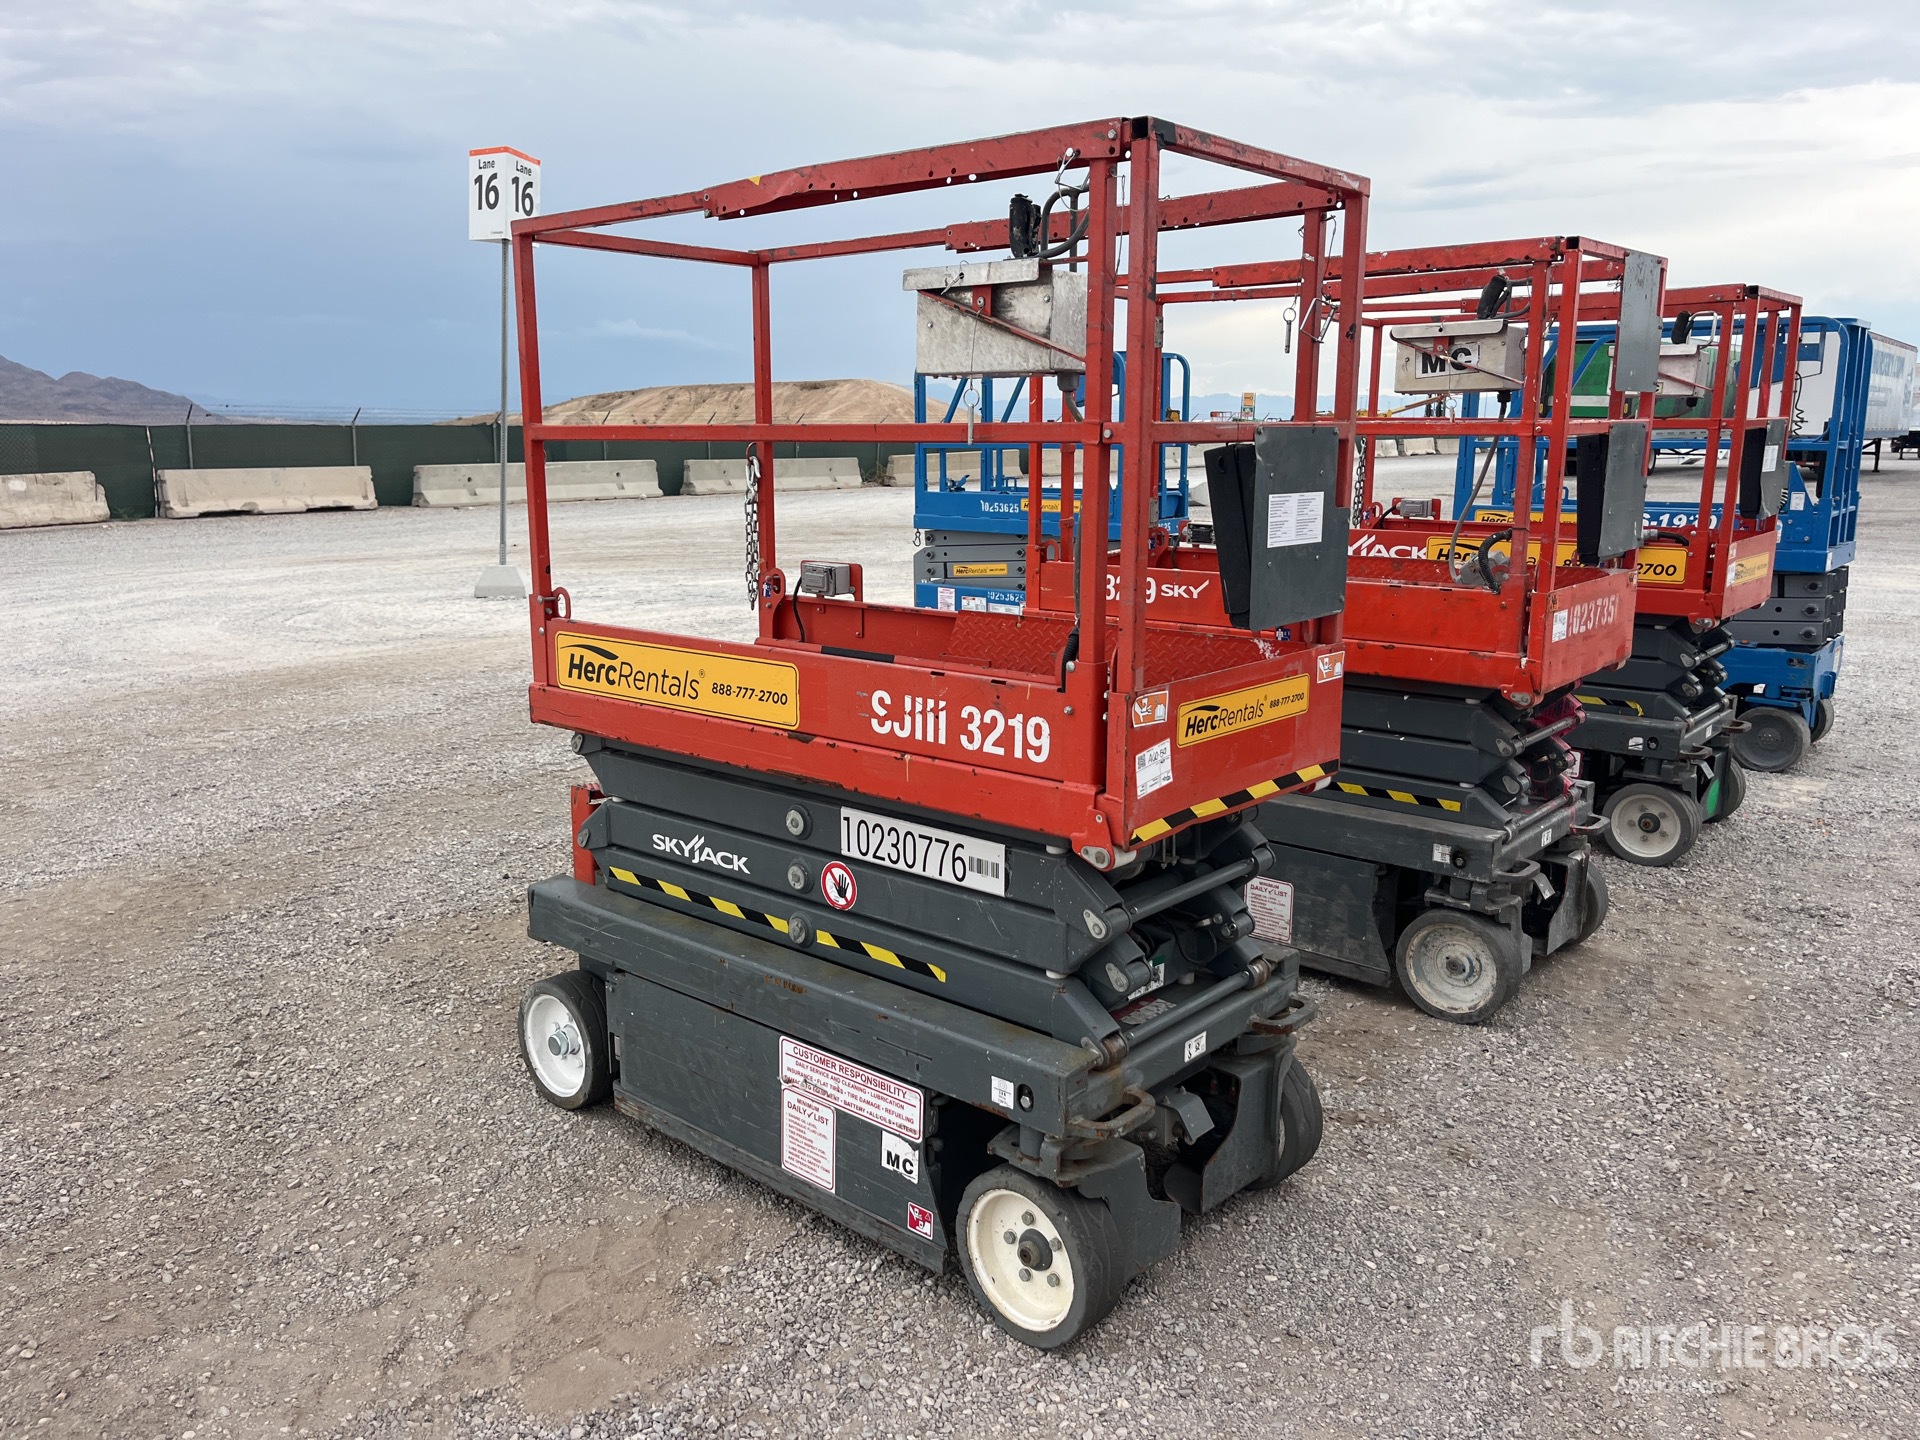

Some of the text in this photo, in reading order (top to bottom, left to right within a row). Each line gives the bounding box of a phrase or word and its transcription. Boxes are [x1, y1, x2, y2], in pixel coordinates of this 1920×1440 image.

[478, 159, 495, 170] Lane
[516, 160, 532, 176] Lane
[474, 172, 499, 210] 16
[511, 176, 534, 217] 16
[567, 653, 788, 706] HercRentals 888-777-2700
[960, 705, 1051, 763] 3219
[1184, 692, 1305, 738] HercRentals 888-777-2700
[652, 833, 751, 875] SKYJACK
[842, 816, 967, 883] 10230776
[793, 1046, 908, 1099] CUSTOMER RESPONSIBILITY
[795, 1060, 905, 1110] DAILY SERVICE AND CLEANING LUBRICATION
[787, 1066, 813, 1082] INSURANCE
[847, 1091, 858, 1100] TIRE
[859, 1096, 881, 1110] DAMAGE
[884, 1107, 914, 1124] REFUELING
[787, 1101, 829, 1126] DAILY LIST
[843, 1099, 866, 1113] BATTERY
[886, 1150, 914, 1175] MC
